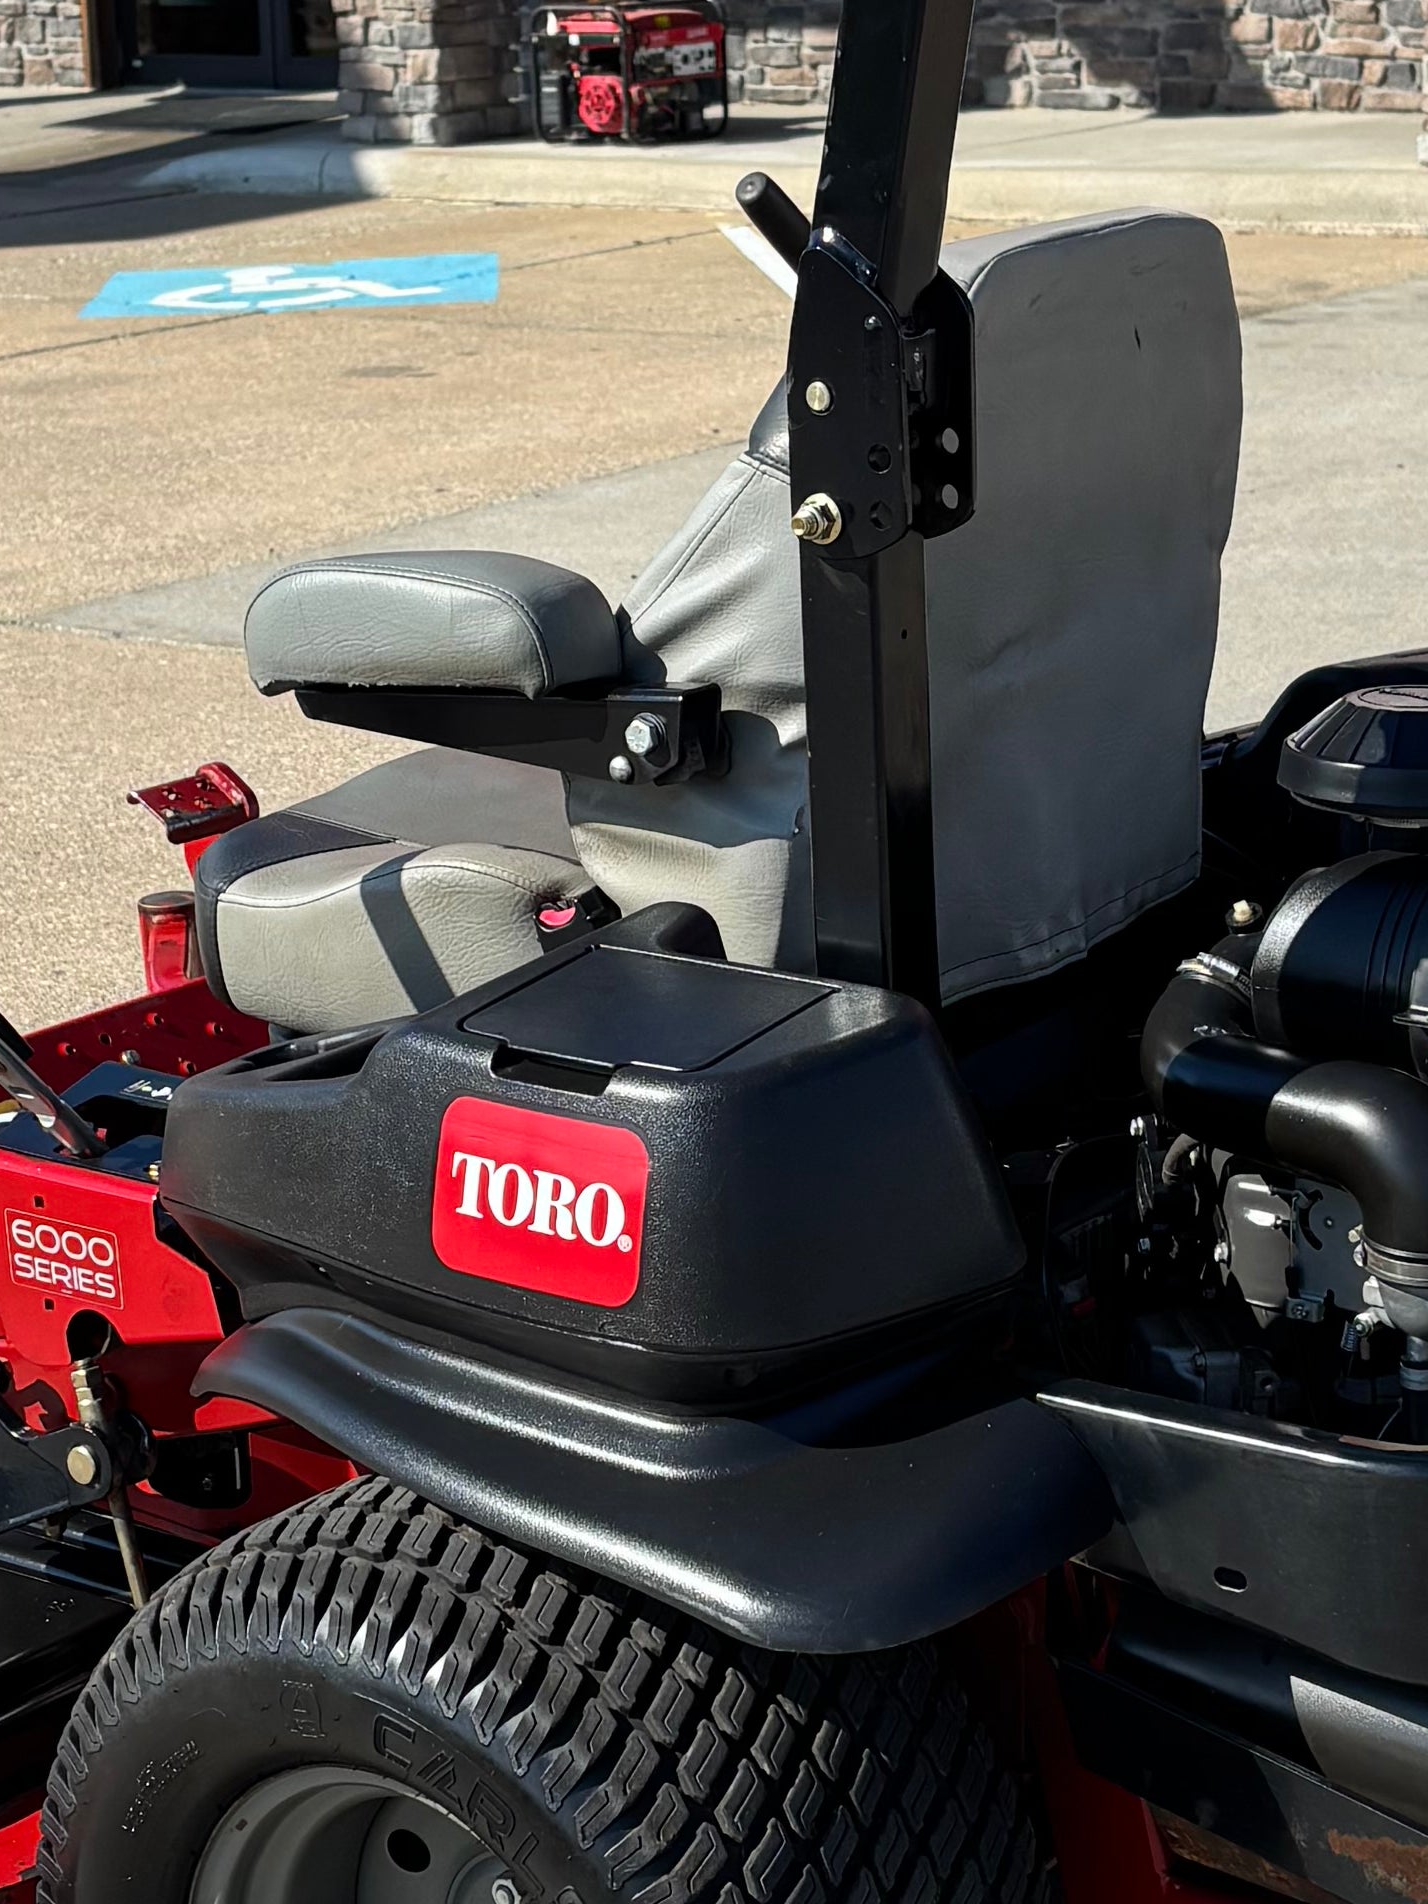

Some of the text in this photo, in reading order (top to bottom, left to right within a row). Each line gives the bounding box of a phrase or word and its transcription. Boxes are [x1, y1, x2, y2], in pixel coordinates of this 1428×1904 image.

[451, 1151, 626, 1247] TORO
[11, 1218, 114, 1267] 6000
[13, 1252, 116, 1298] SERIES
